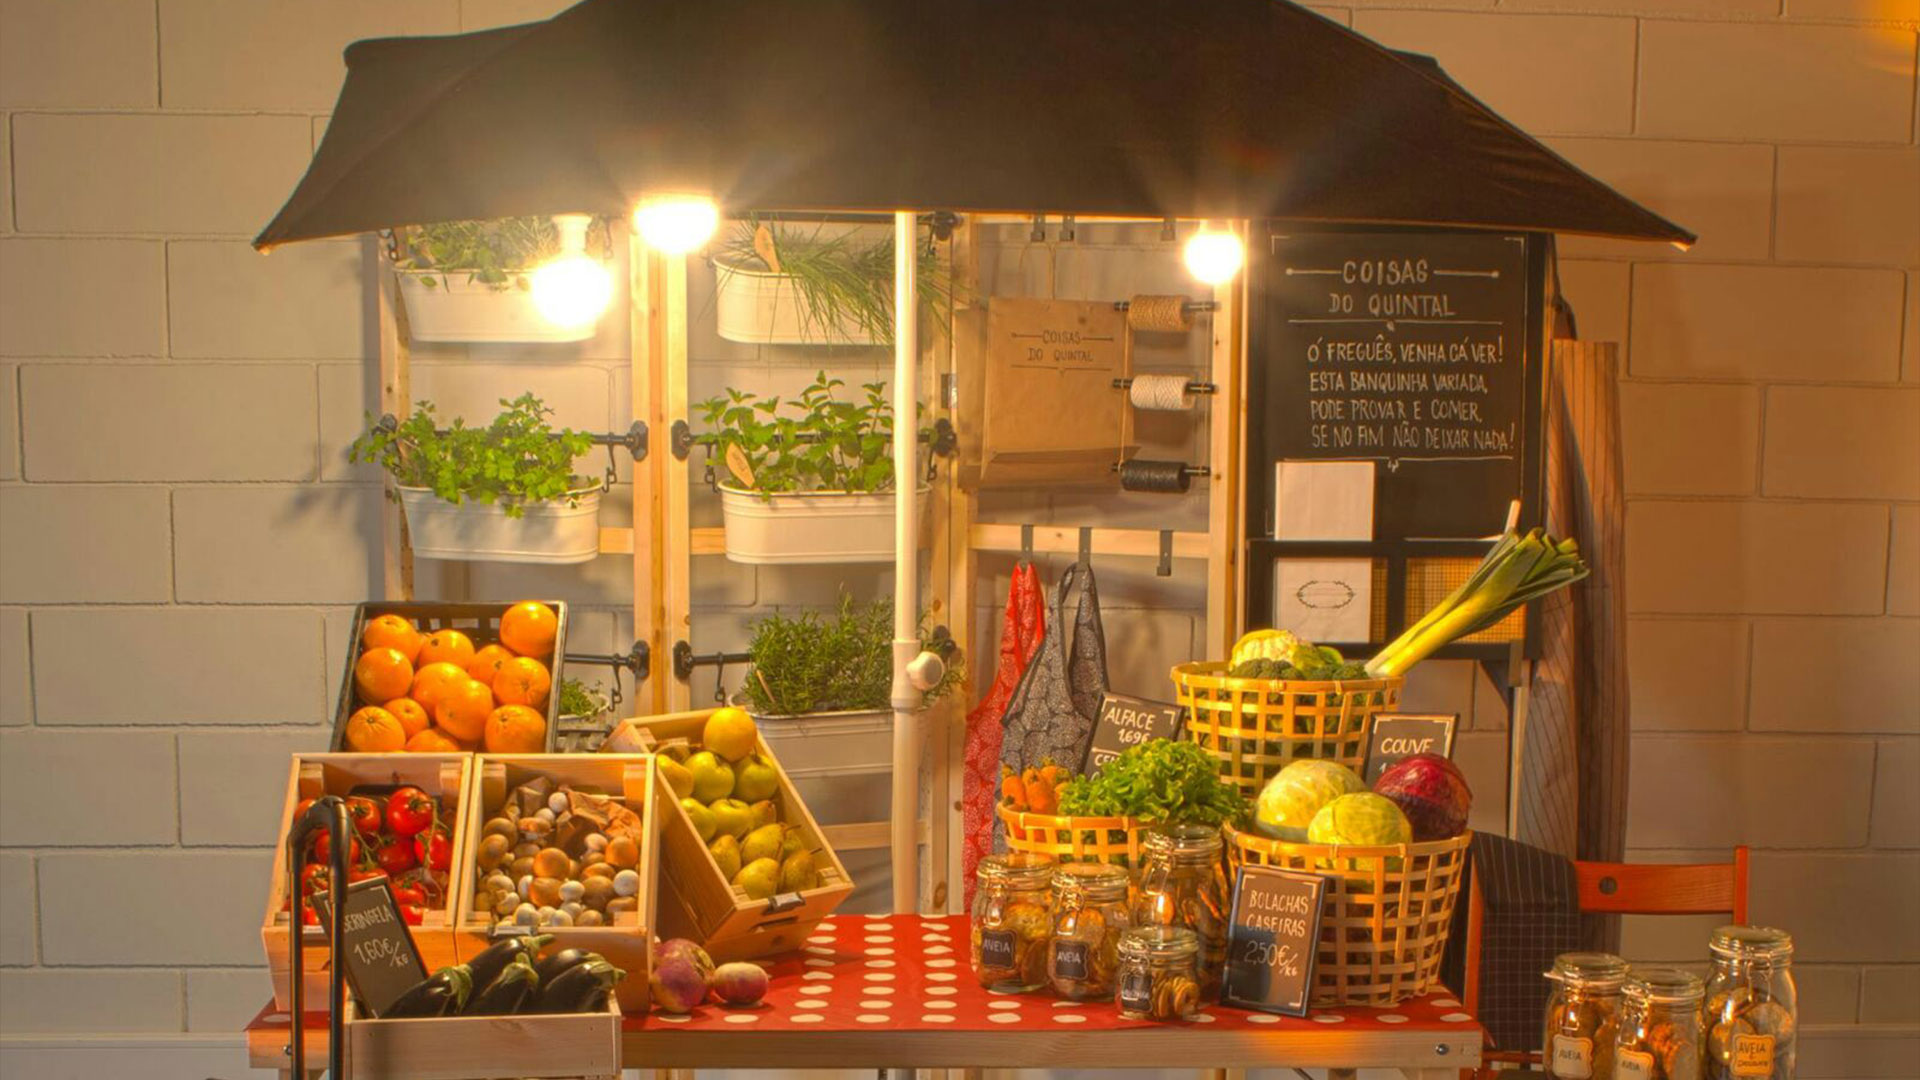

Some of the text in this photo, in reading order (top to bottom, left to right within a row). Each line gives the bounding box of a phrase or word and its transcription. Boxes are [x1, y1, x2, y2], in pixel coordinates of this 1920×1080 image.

[1342, 258, 1429, 286] COISAS
[1328, 292, 1456, 317] DO QUINTAL
[1042, 329, 1082, 346] COISAS
[1307, 333, 1503, 364] Ó FREGUÊS, VENHA CÁ VER!
[1027, 347, 1095, 363] DO QUINTAL
[1309, 371, 1488, 395] ESTA BANQUINHA VARIADA,
[1310, 399, 1483, 423] PODE PROVAR E COMER,
[1311, 420, 1515, 453] SE NO FIM NÃO DEIXAR NADA!
[1103, 706, 1157, 731] ALFACE
[1248, 889, 1309, 915] BOLACHAS
[1245, 913, 1306, 938] CASEIRAS
[982, 938, 1011, 954] AVEIA
[1056, 950, 1082, 964] AVEIA
[1739, 1041, 1767, 1054] AVEIA
